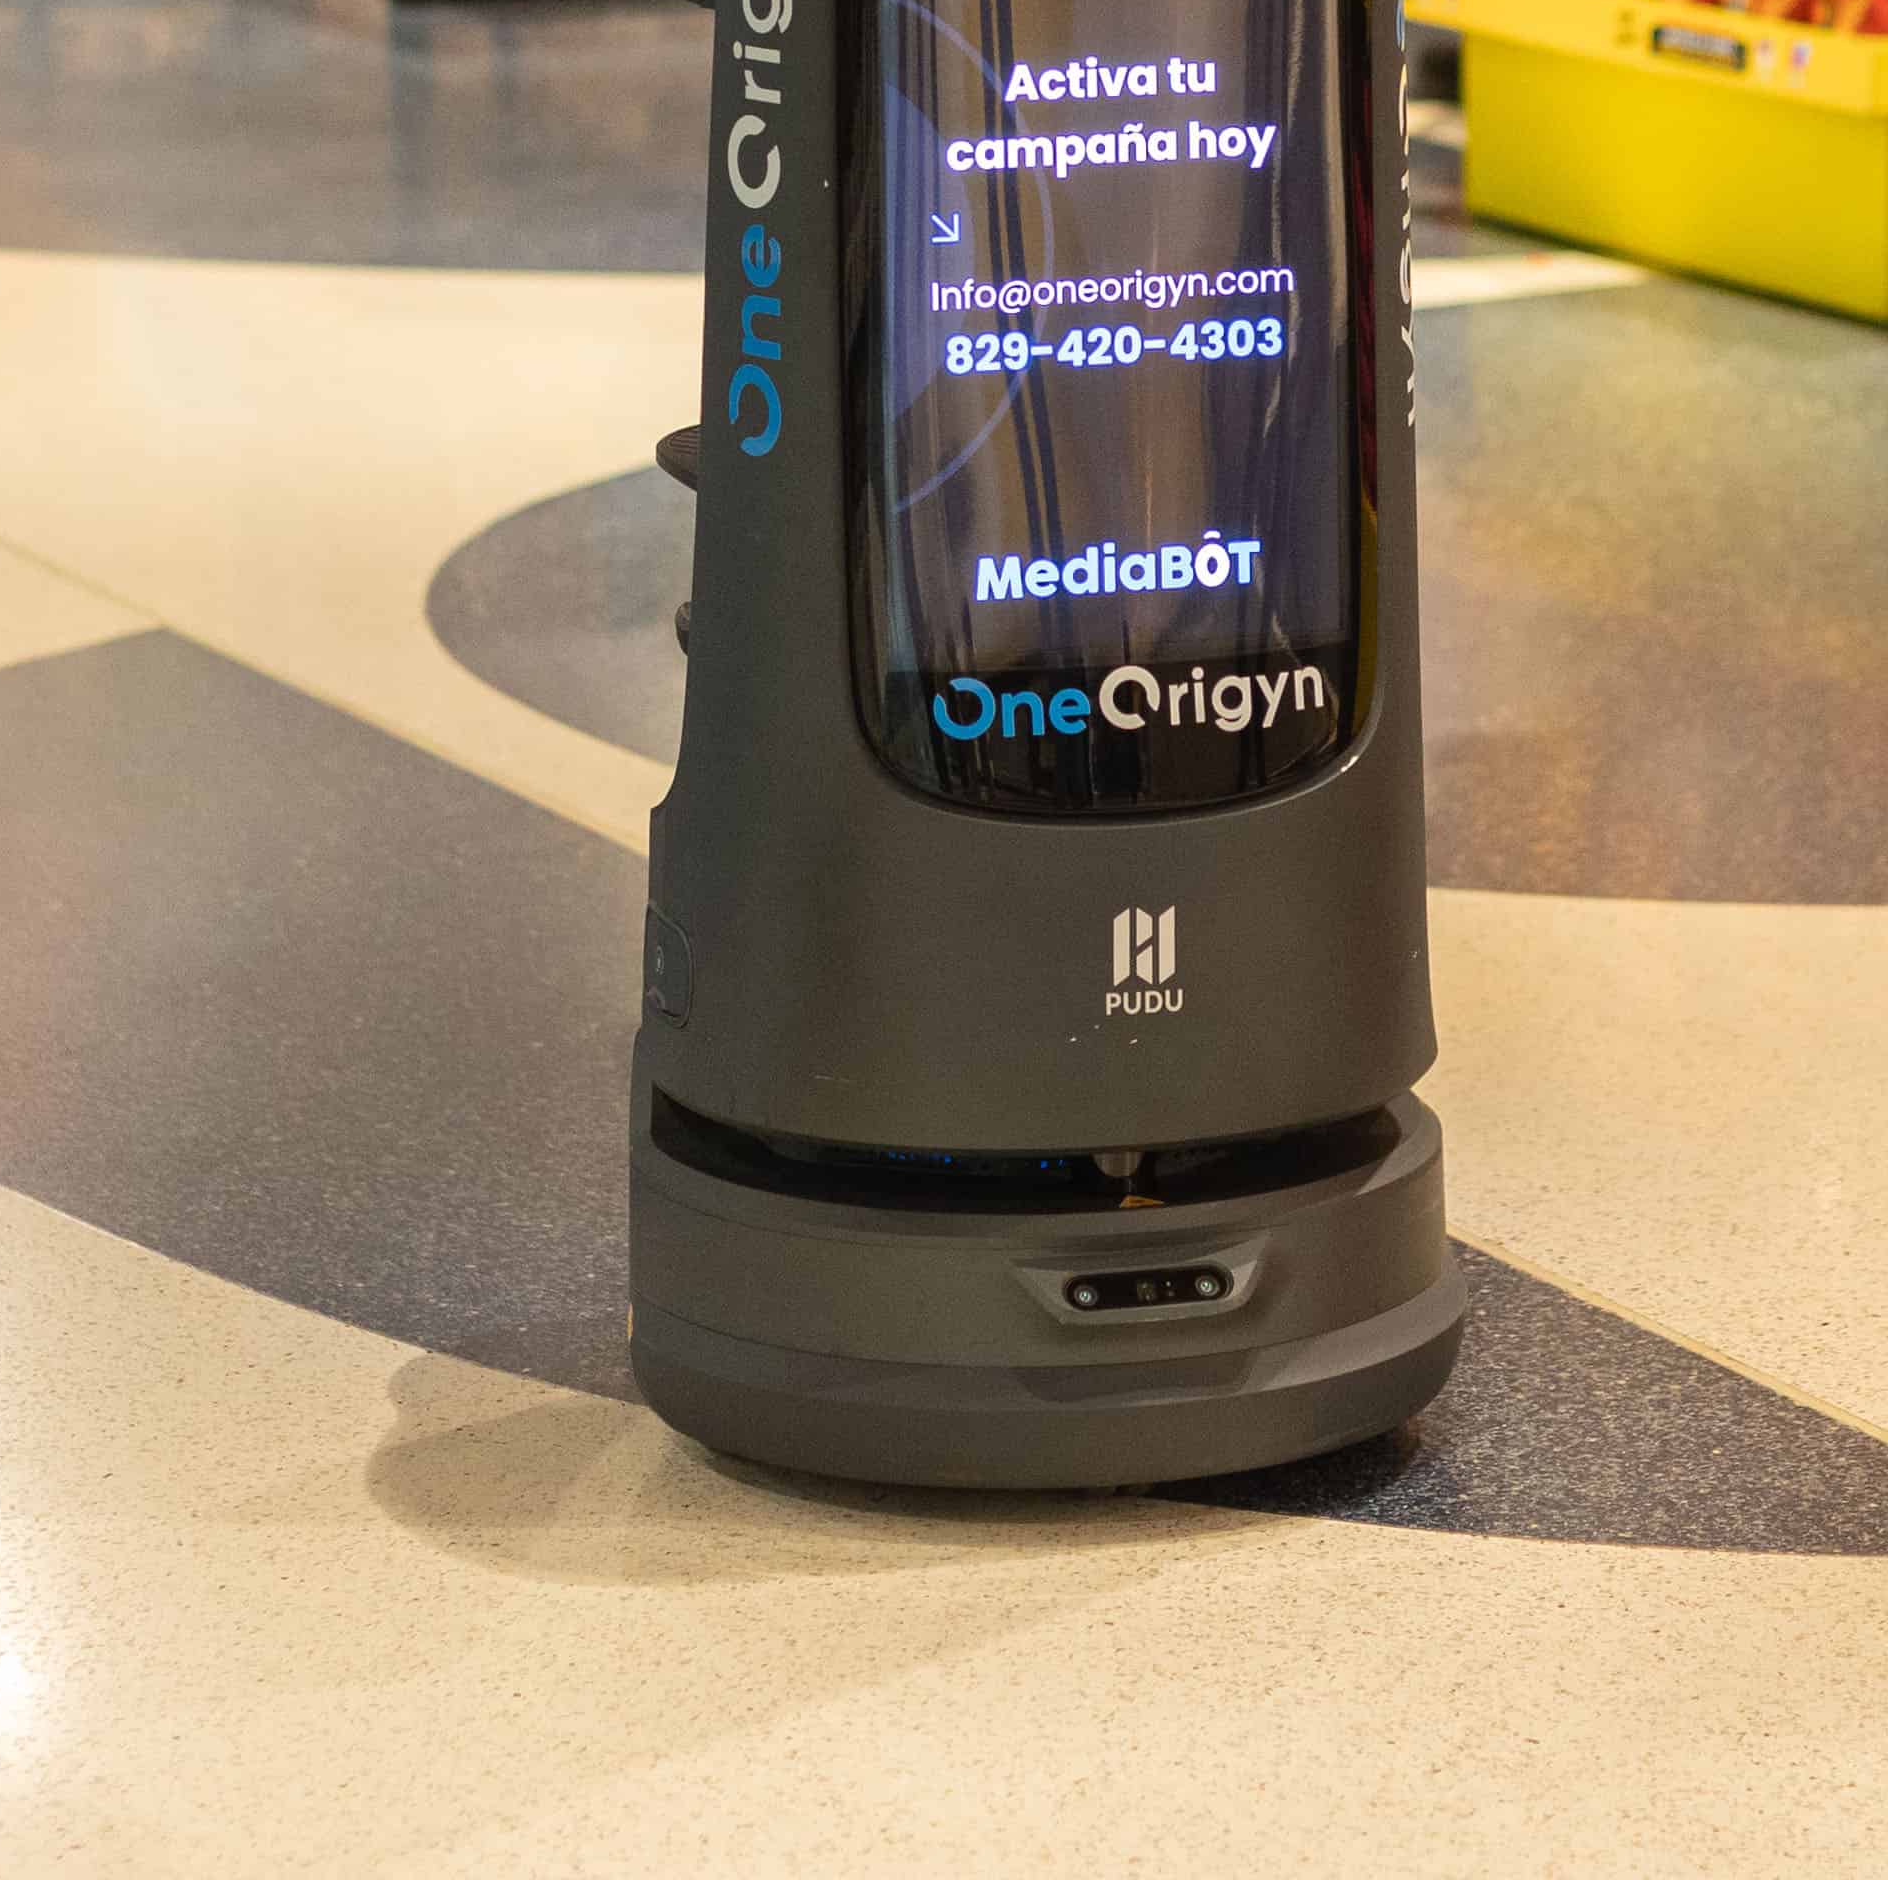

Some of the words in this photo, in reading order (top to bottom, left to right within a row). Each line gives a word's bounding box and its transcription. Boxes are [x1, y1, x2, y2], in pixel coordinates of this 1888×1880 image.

[1004, 56, 1158, 102] Activa
[1166, 56, 1217, 94] tu
[945, 122, 1178, 179] campaña
[1187, 120, 1277, 169] hoy
[930, 267, 1295, 313] Info@oneorigyn.com
[945, 318, 1284, 376] 829-420-4303
[933, 664, 1325, 741] OneOrigyn
[1104, 987, 1184, 1017] PUDU
